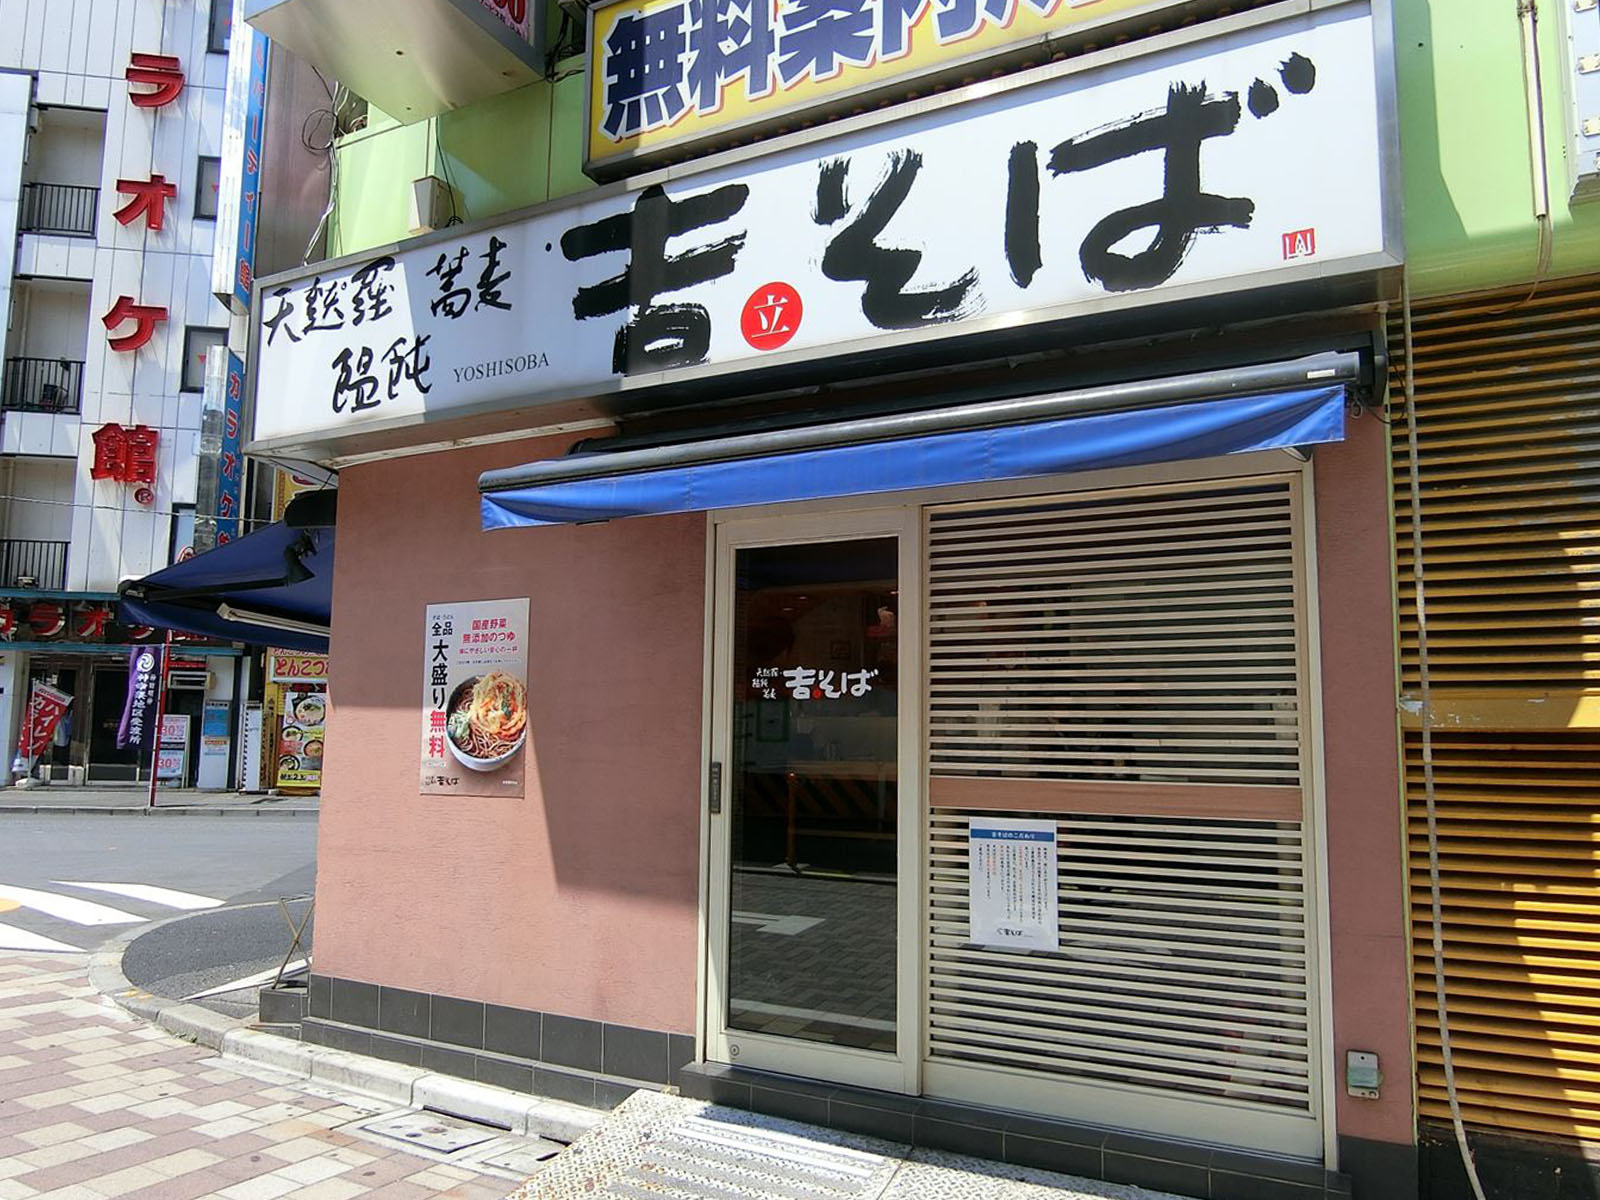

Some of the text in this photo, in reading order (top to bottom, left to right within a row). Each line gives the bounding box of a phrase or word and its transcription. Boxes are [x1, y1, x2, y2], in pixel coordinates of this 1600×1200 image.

[602, 0, 1106, 139] 無料案
[559, 51, 1317, 374] 吉そば
[750, 294, 791, 338] 立
[453, 353, 550, 384] YOSHISOBA
[432, 621, 453, 636] 全品
[472, 618, 507, 631] 国産野菜
[275, 658, 329, 677] とんこつ
[783, 666, 879, 700] 吉そば
[429, 639, 449, 758] 大盛り無料
